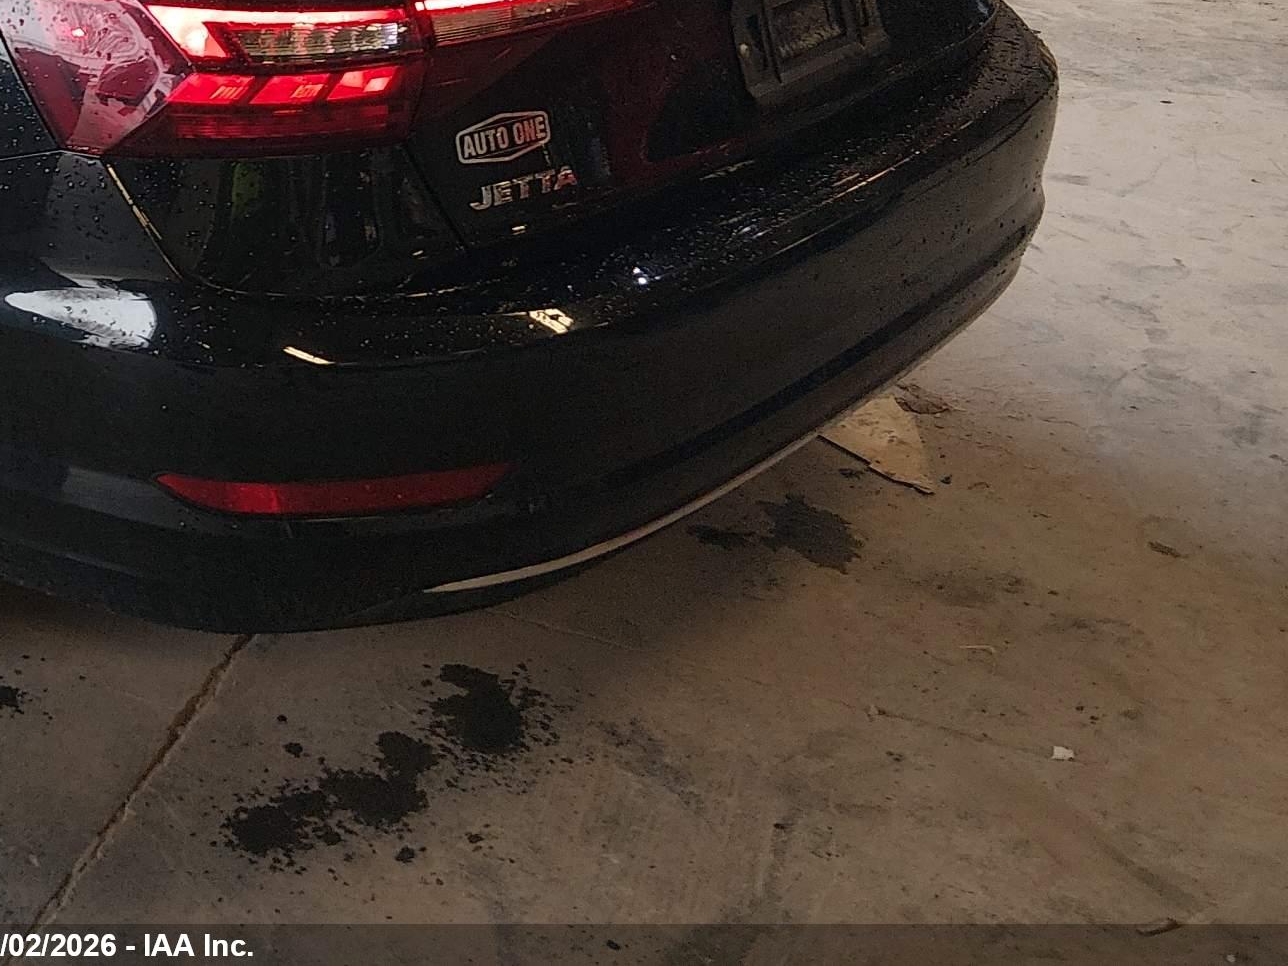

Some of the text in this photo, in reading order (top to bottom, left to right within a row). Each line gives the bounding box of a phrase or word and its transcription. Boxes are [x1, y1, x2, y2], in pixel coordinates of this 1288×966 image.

[463, 116, 546, 159] AUTO ONE
[468, 165, 578, 211] JETTA
